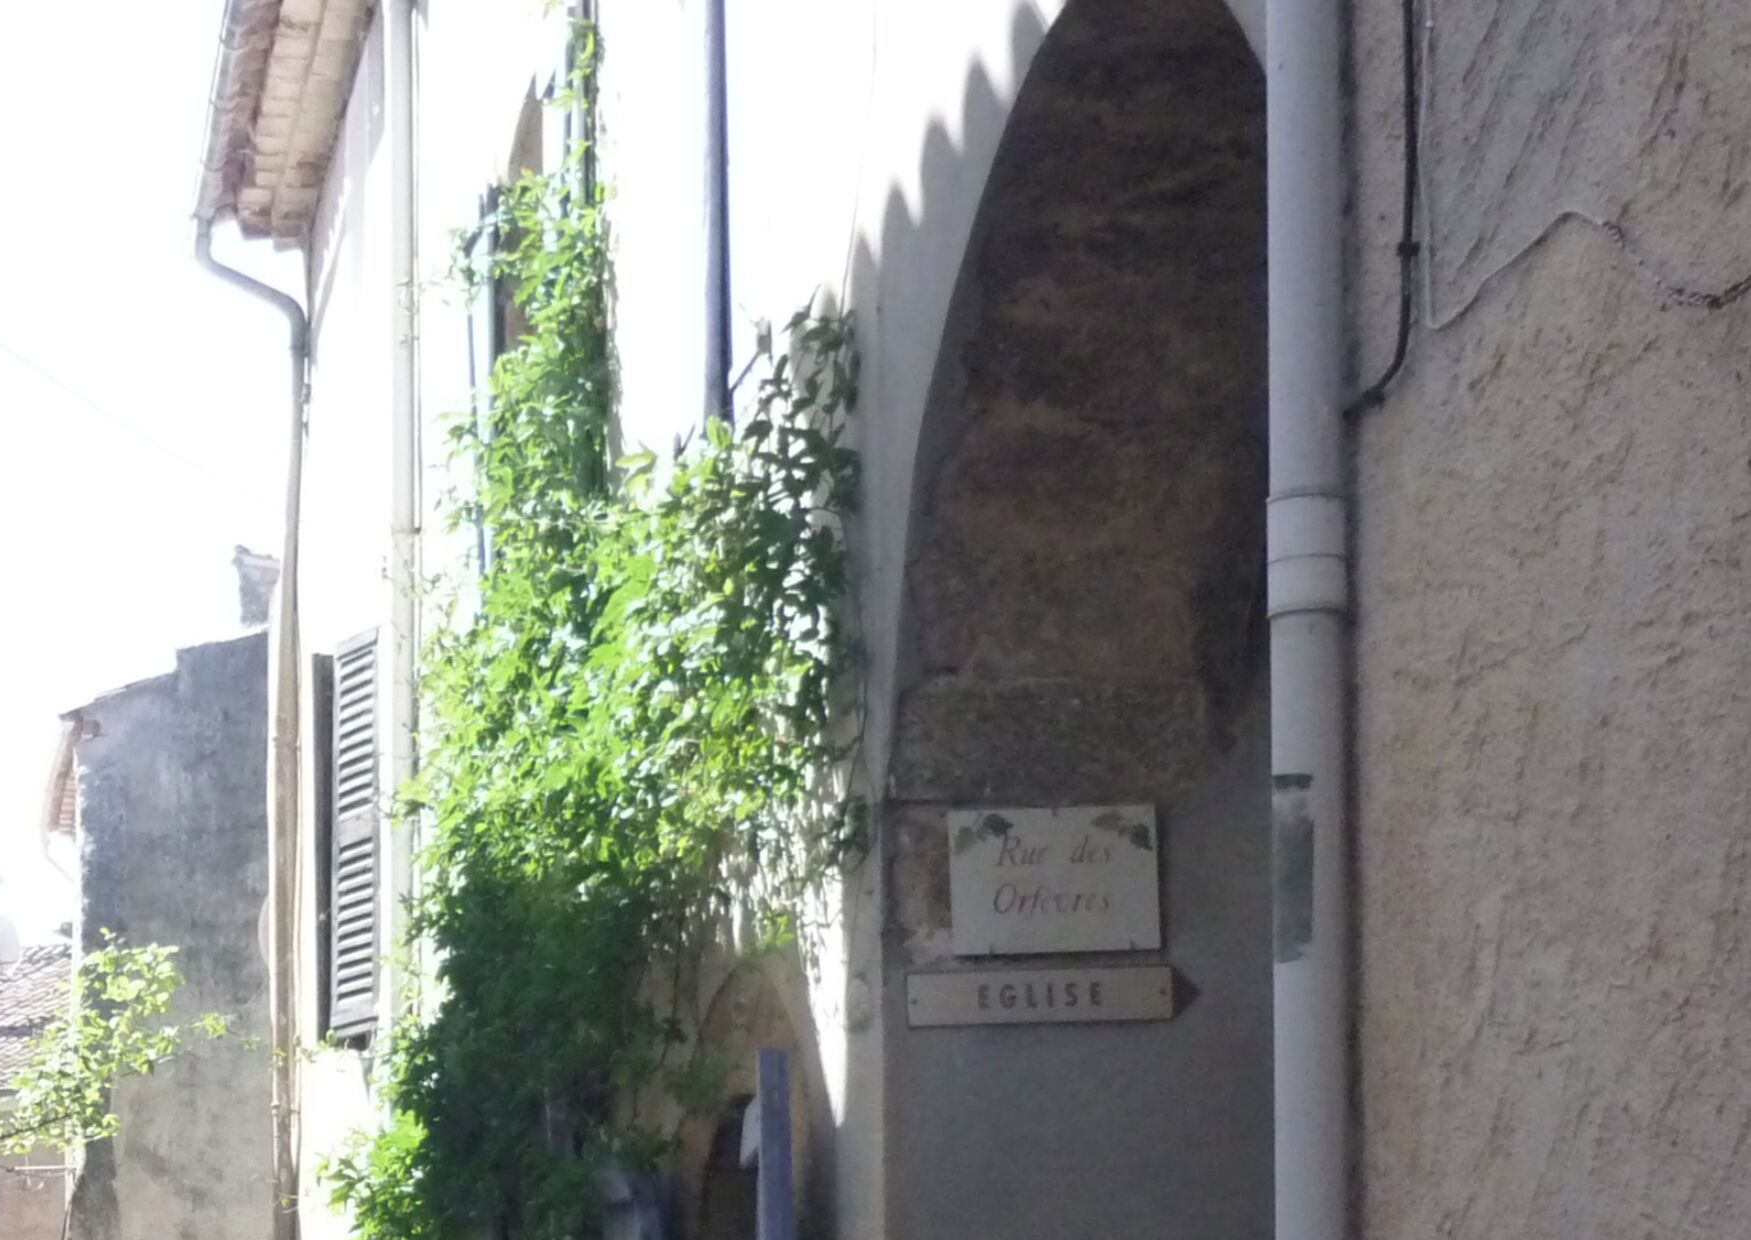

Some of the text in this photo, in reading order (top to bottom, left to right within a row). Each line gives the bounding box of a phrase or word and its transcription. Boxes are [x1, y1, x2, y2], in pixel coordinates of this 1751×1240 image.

[996, 834, 1112, 866] Rue des
[977, 981, 1103, 1009] EGLISE
